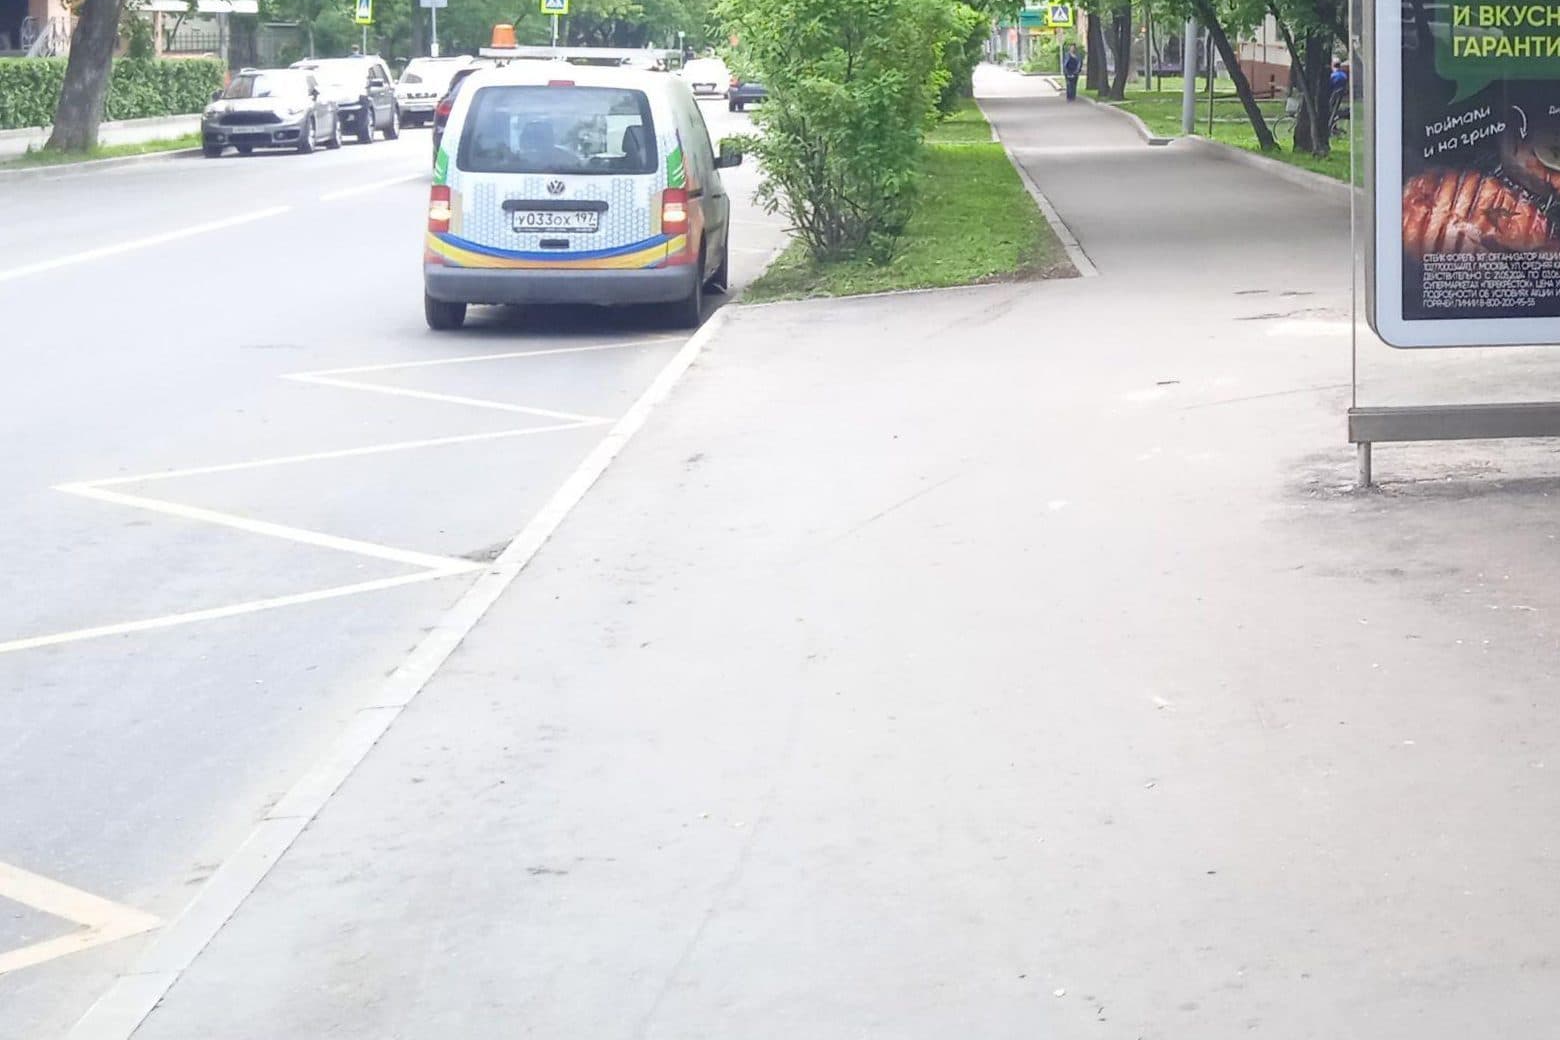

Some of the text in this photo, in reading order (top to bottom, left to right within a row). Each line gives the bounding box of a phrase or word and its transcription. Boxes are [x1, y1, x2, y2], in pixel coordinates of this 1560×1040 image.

[1453, 6, 1470, 27] И
[1425, 106, 1490, 137] поймали
[1424, 122, 1506, 158] и на гриль
